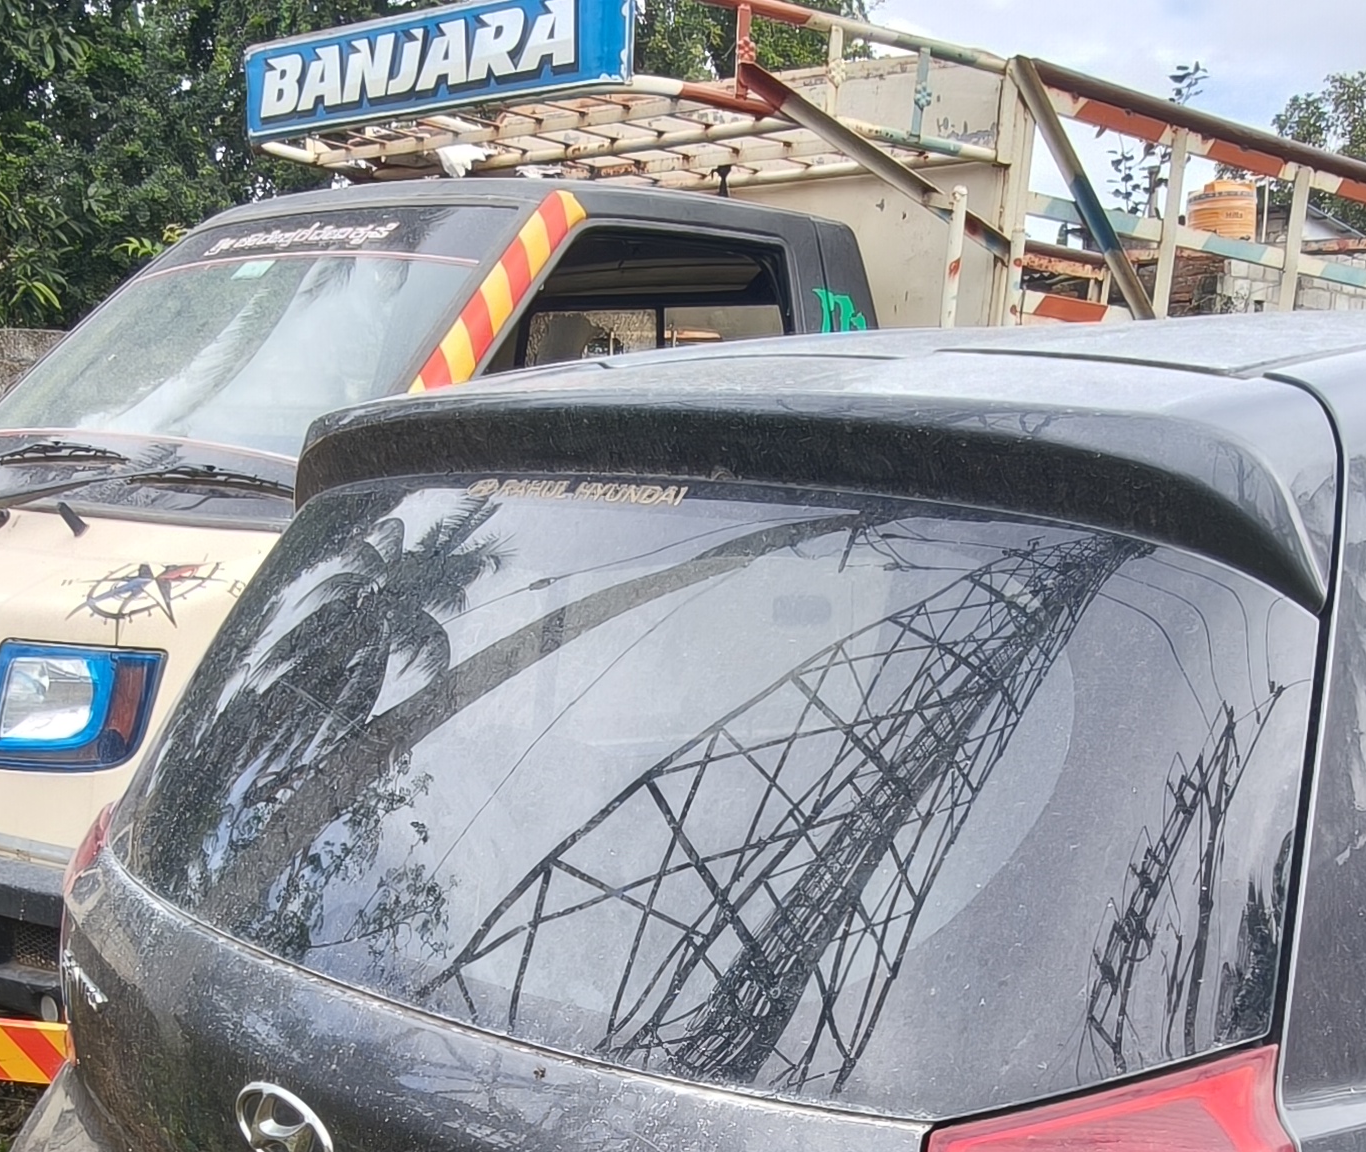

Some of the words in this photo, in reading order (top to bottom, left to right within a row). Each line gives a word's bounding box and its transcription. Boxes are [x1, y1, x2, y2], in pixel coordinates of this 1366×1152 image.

[260, 0, 576, 118] BANJARA
[495, 478, 570, 500] RAHUL
[572, 480, 689, 507] HYUNDAI
